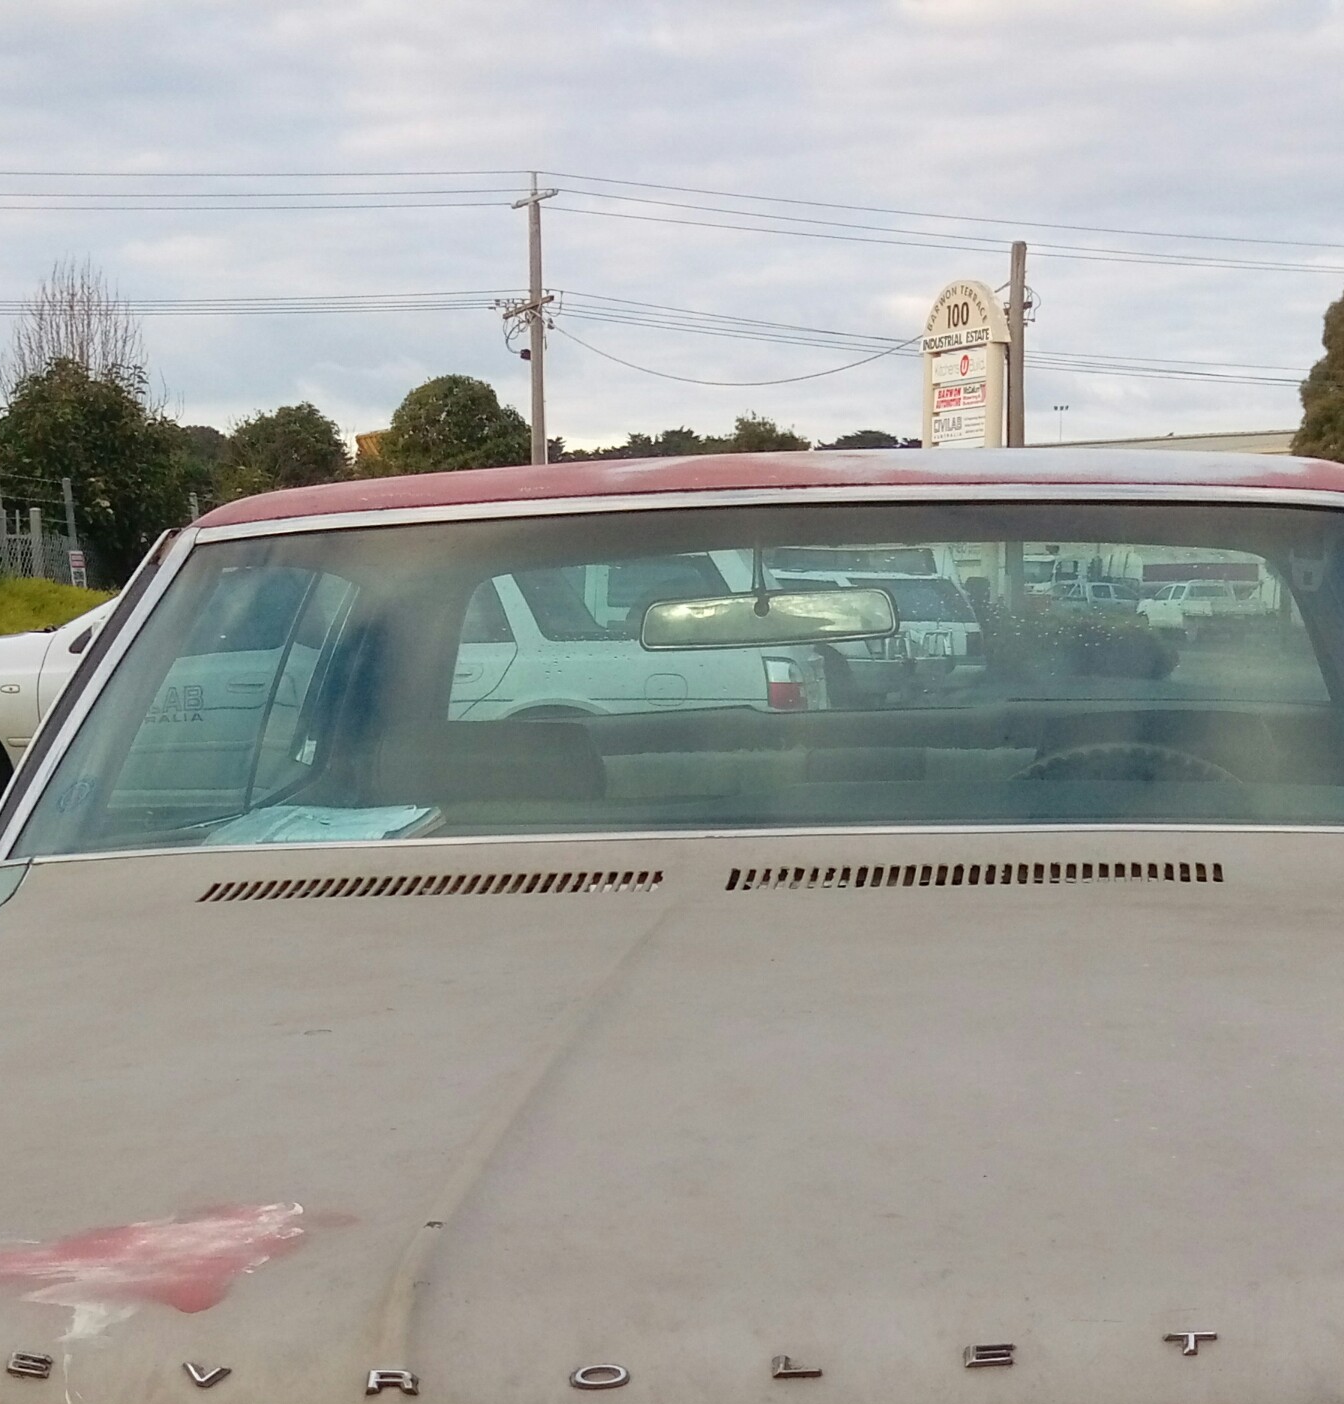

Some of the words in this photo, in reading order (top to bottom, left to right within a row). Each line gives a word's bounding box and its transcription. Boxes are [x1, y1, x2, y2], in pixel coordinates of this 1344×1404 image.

[927, 286, 957, 331] BARWON
[961, 285, 987, 323] TERRACE
[947, 302, 969, 329] 100
[923, 334, 962, 351] INDUSTRIAL
[966, 328, 990, 342] ESTATE
[938, 388, 962, 399] BARWON
[934, 417, 962, 433] CIVILAB
